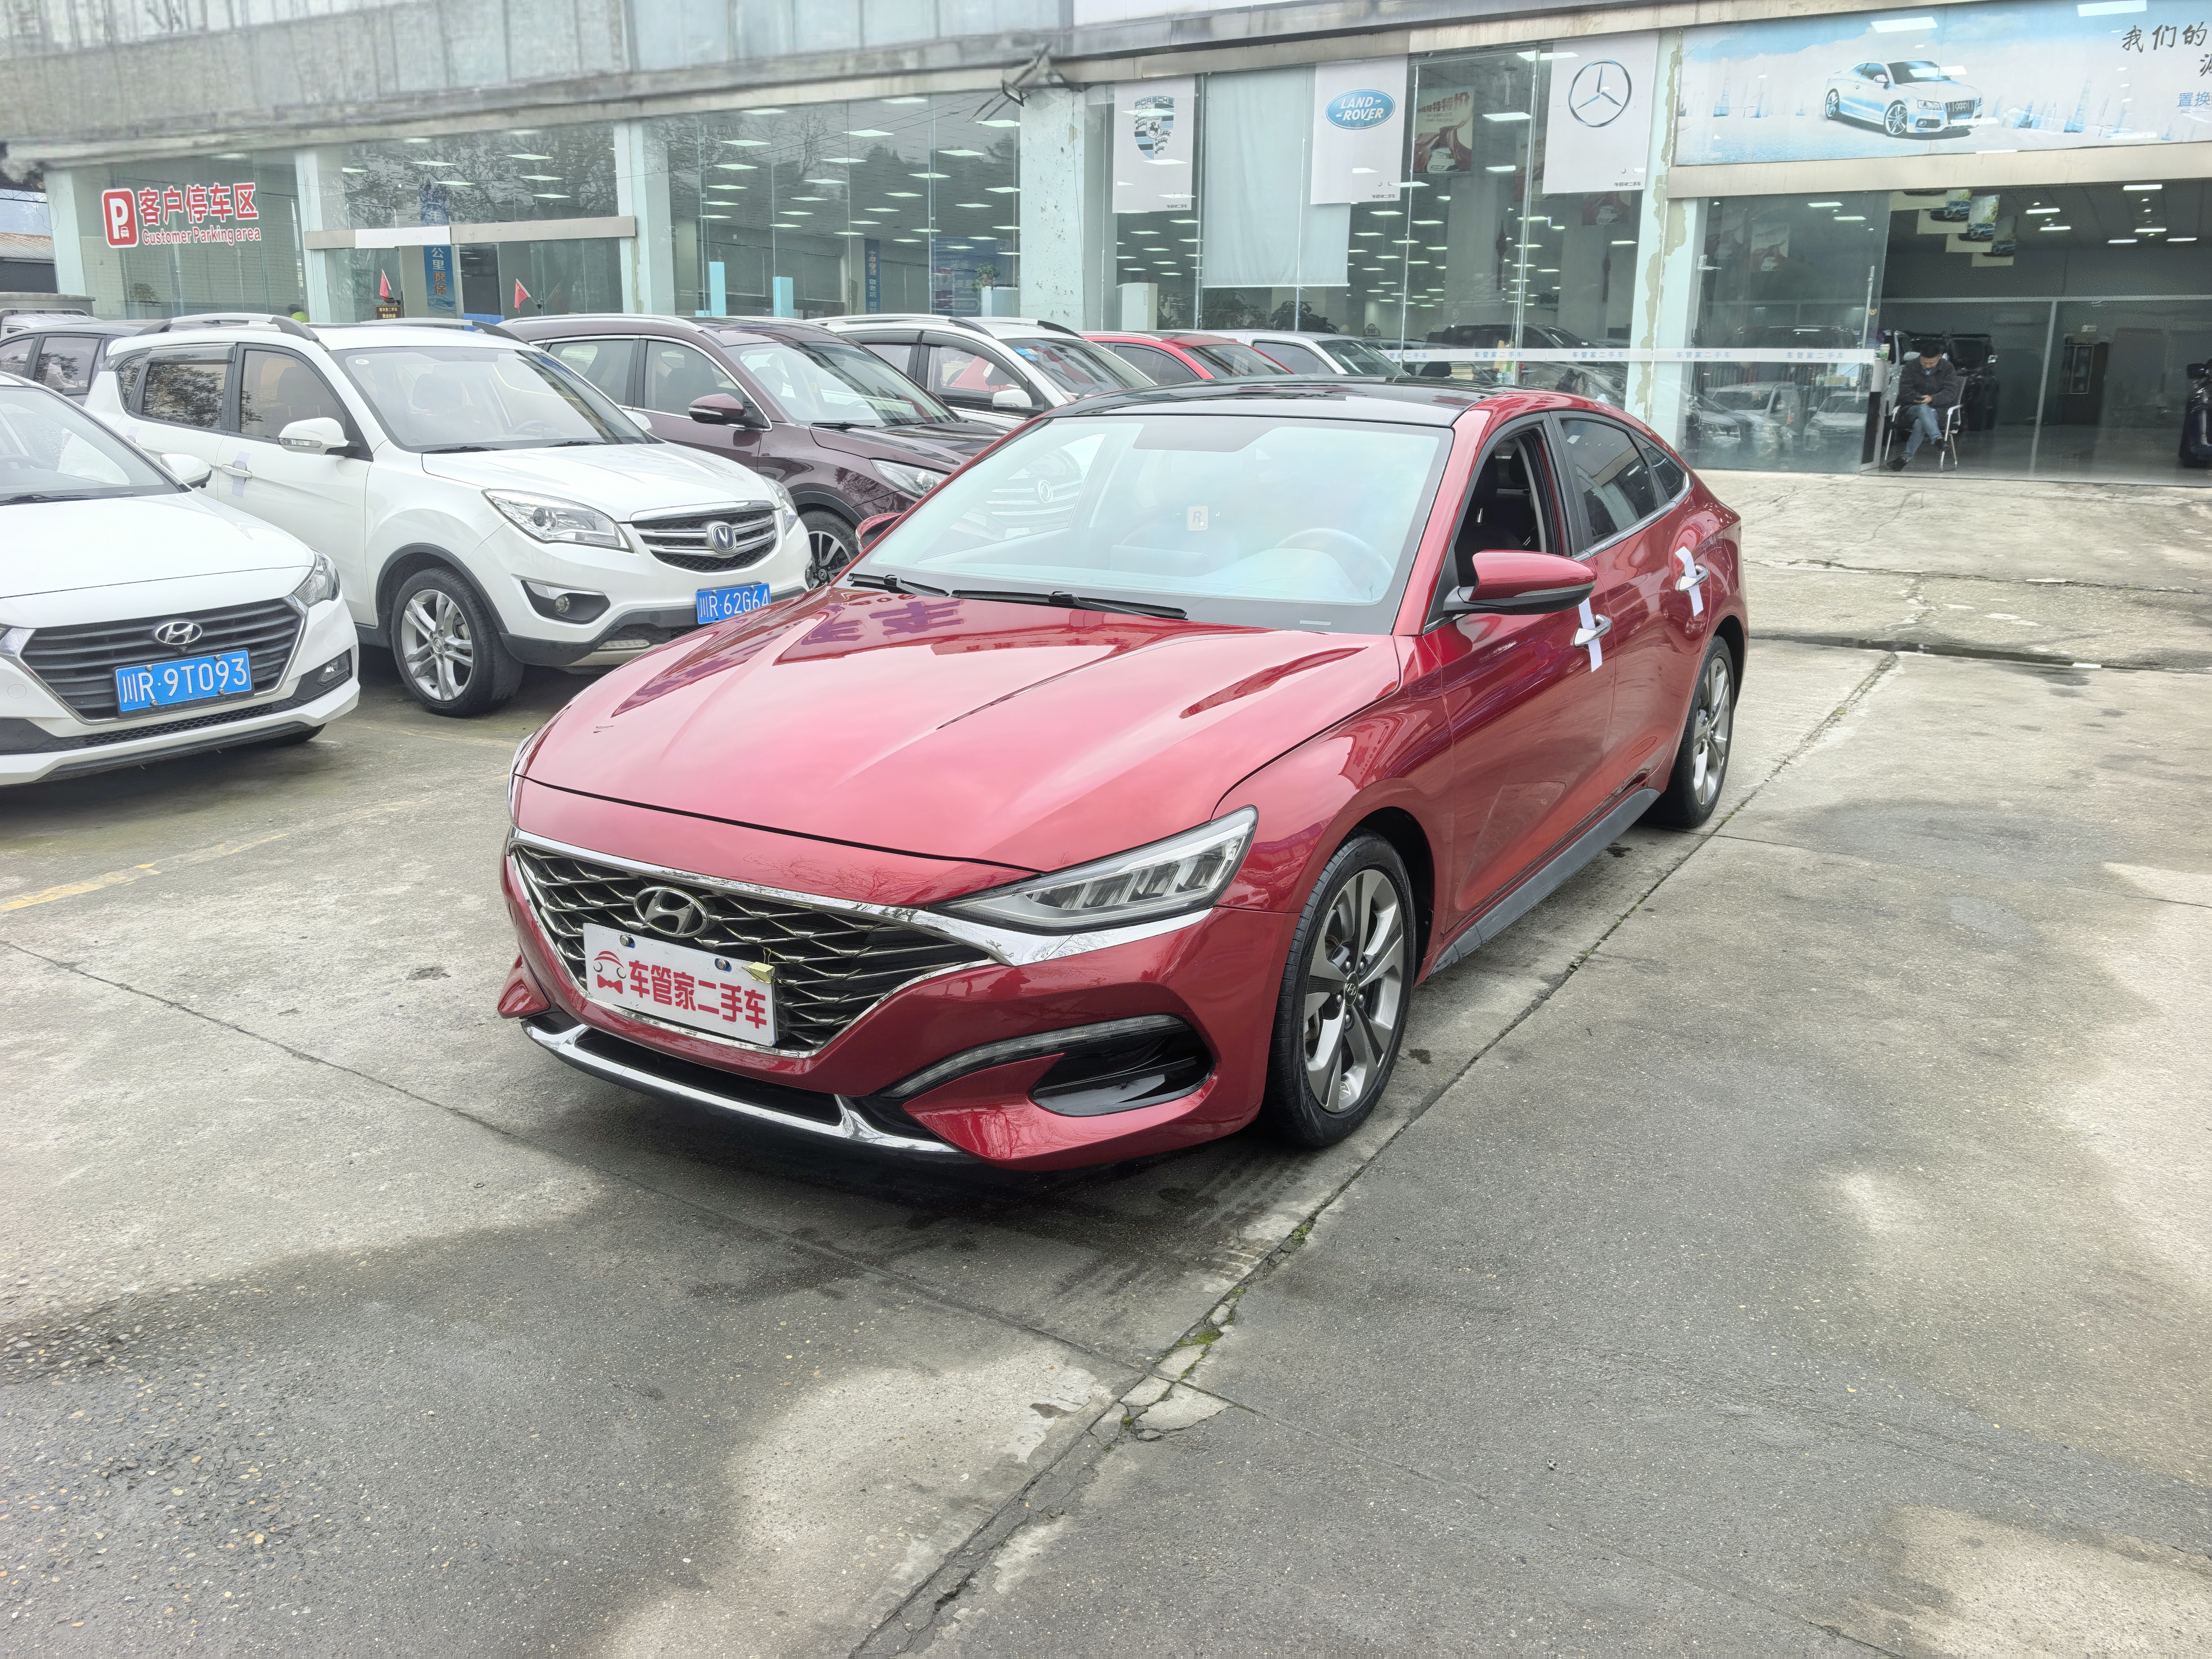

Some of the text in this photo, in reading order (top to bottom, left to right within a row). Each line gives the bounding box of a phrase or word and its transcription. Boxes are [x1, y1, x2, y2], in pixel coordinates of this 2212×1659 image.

[2122, 21, 2207, 53] 我们的
[1340, 96, 1374, 109] LAND
[1342, 107, 1384, 121] ROVER
[137, 183, 259, 226] 客户停车区
[142, 225, 261, 246] Customer Parking area
[628, 960, 767, 1029] 车管家二手车
